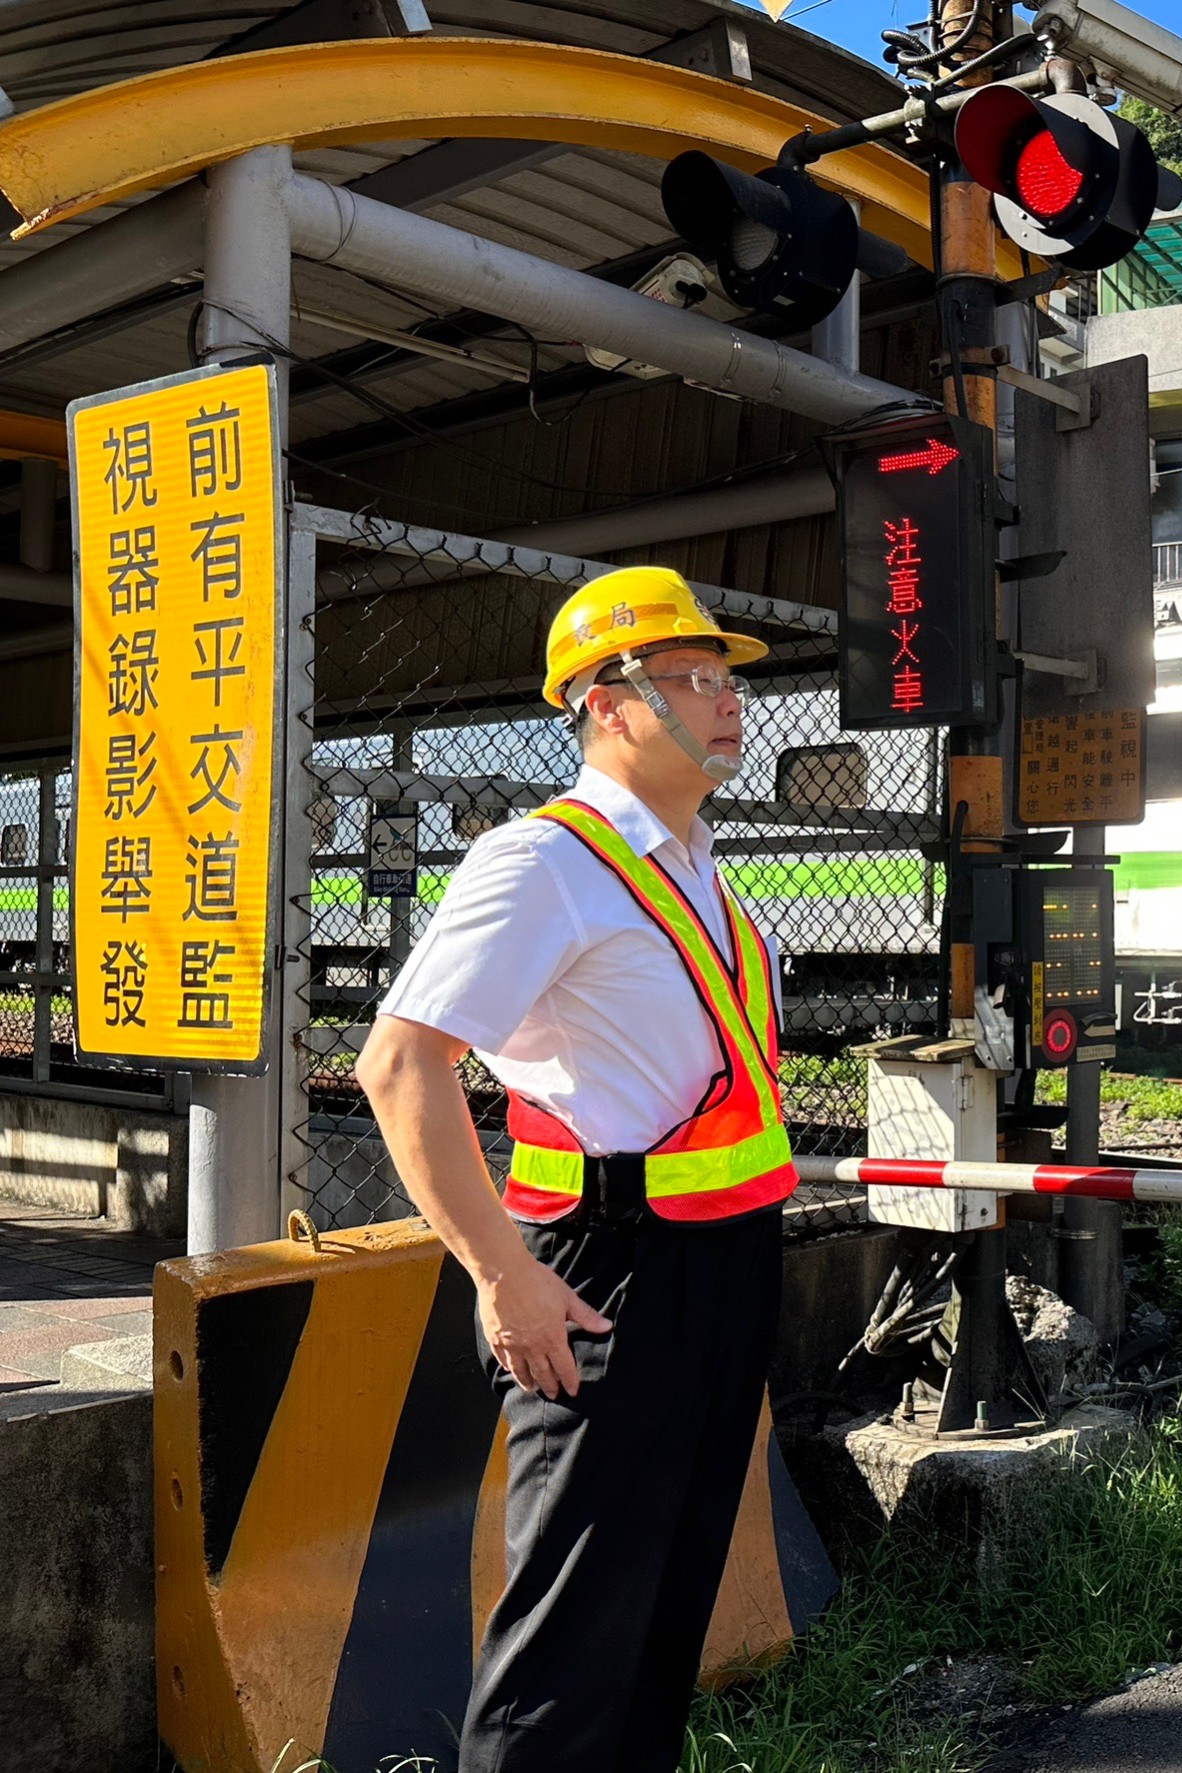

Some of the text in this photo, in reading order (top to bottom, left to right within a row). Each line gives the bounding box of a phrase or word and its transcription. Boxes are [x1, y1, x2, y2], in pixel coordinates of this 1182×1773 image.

[100, 421, 160, 1028] 視器錄影舉發
[177, 401, 246, 1029] 前有平交道監
[884, 517, 924, 713] 注意火車
[1120, 711, 1137, 787] 監視中
